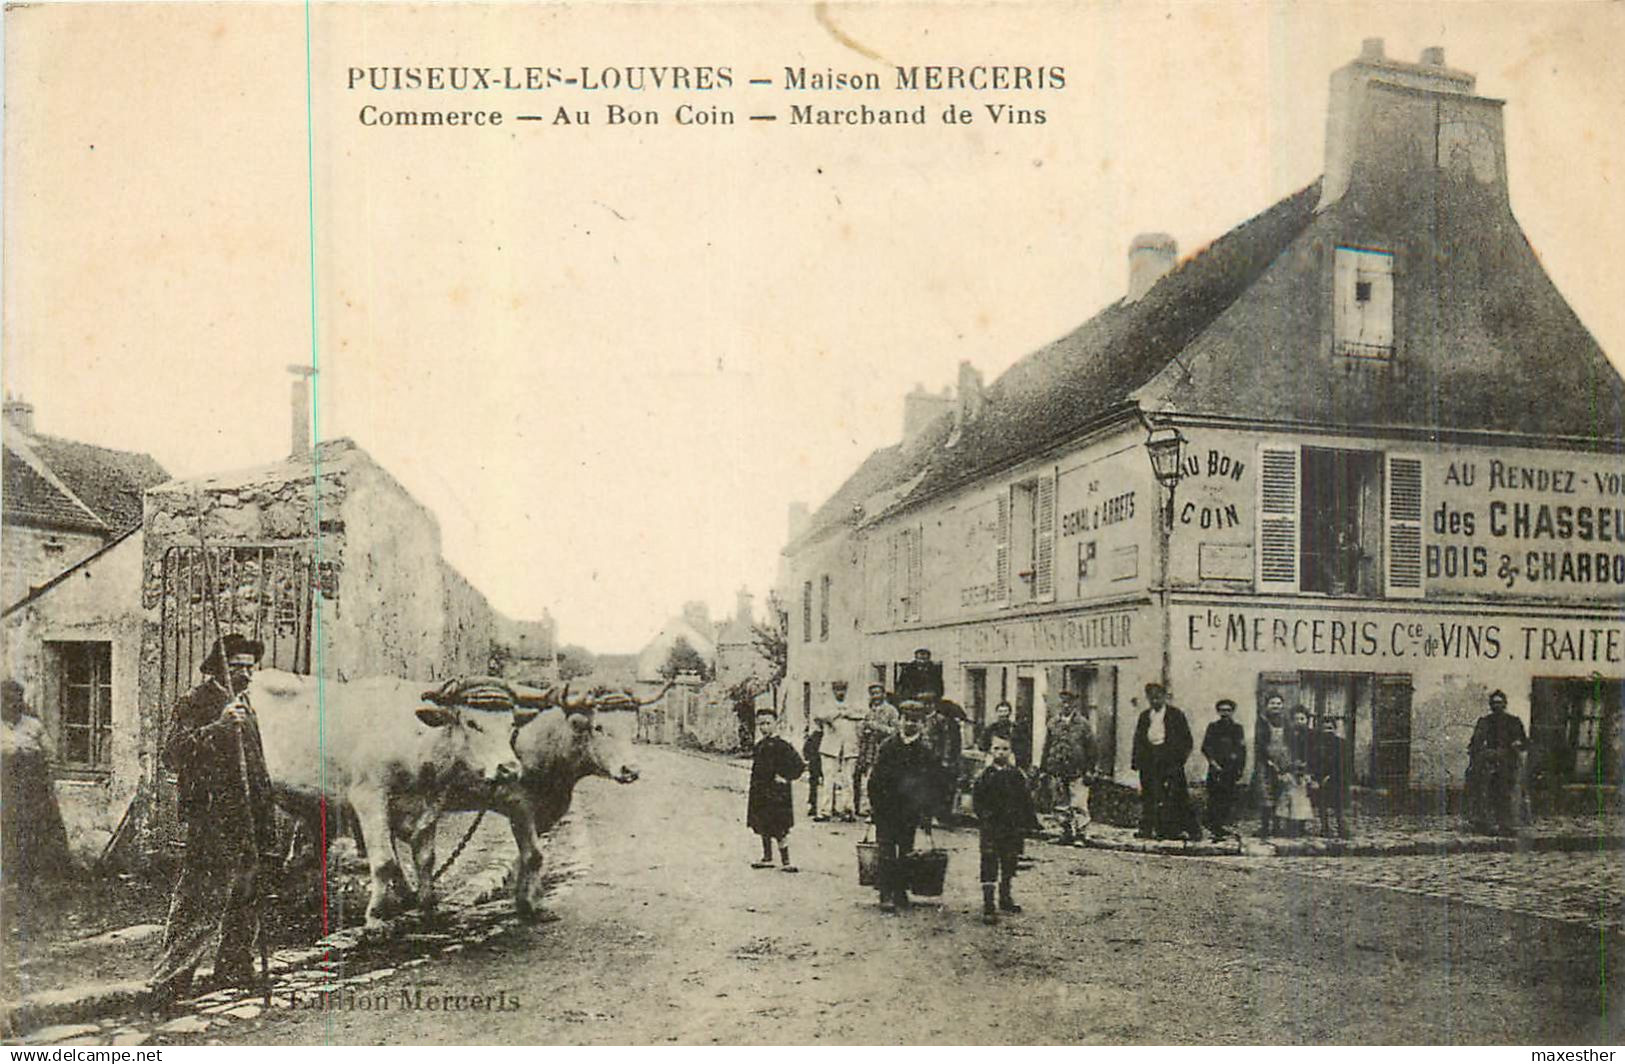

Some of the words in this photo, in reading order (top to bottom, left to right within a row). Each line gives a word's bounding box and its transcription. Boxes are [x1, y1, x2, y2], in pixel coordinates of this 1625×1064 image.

[1208, 450, 1245, 482] BON
[1445, 463, 1475, 487] AU
[1180, 502, 1240, 529] COIN
[1434, 502, 1475, 536] des
[1426, 545, 1487, 578] BOIS
